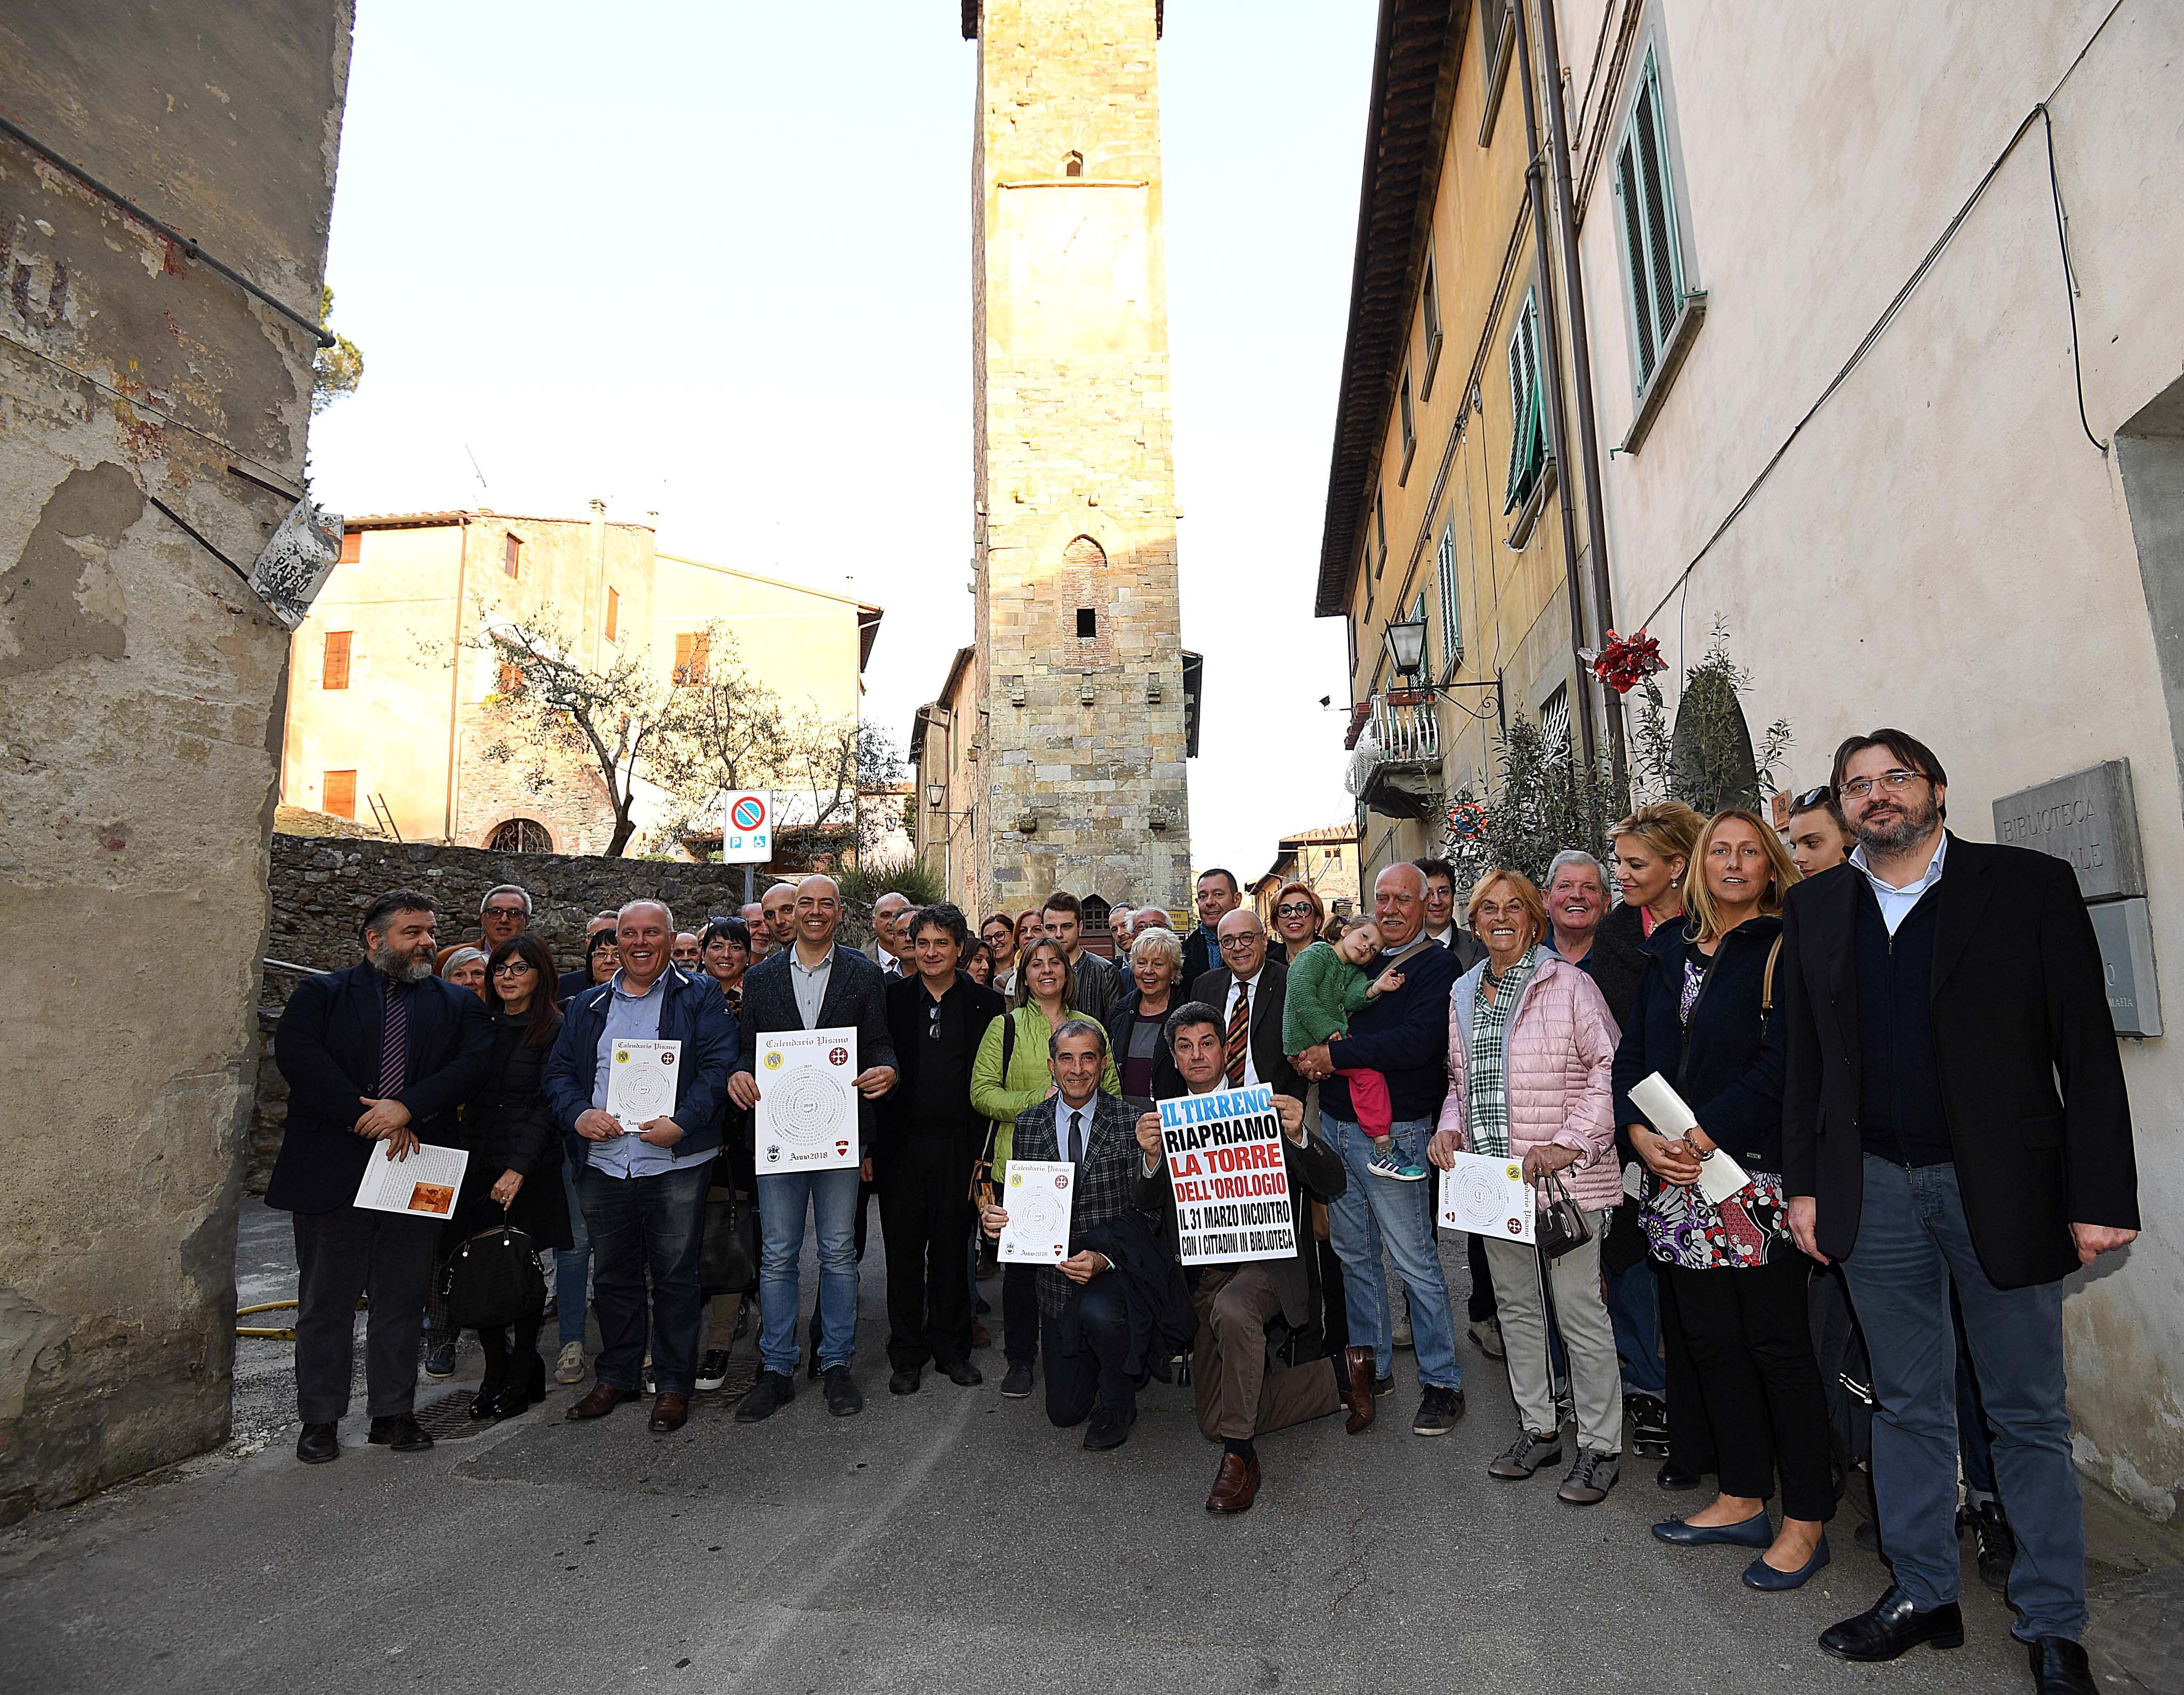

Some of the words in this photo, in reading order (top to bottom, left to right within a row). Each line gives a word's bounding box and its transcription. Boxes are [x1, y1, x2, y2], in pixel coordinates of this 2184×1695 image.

[273, 556, 309, 593] PASSO
[2003, 797, 2095, 843] BIBLIOTECA
[766, 1038, 814, 1048] Calendario
[816, 1036, 849, 1047] Pisano
[1160, 1103, 1182, 1128] IL
[1182, 1088, 1272, 1124] TIRRENO
[1164, 1114, 1278, 1153] RIAPRIAMO
[1170, 1154, 1203, 1178] LA
[1203, 1143, 1283, 1174] TORRE
[1175, 1172, 1287, 1203] DELL'OROLOGIO
[1179, 1209, 1189, 1231] IL
[1190, 1208, 1201, 1230] 31
[1204, 1205, 1239, 1229] MARZO
[1241, 1200, 1290, 1226] INCONTRO
[1182, 1235, 1197, 1257] CON
[1199, 1234, 1202, 1256] I
[1203, 1232, 1238, 1255] CITTADINI
[1240, 1231, 1248, 1253] IN
[1249, 1228, 1294, 1252] BIBLIOTECA
